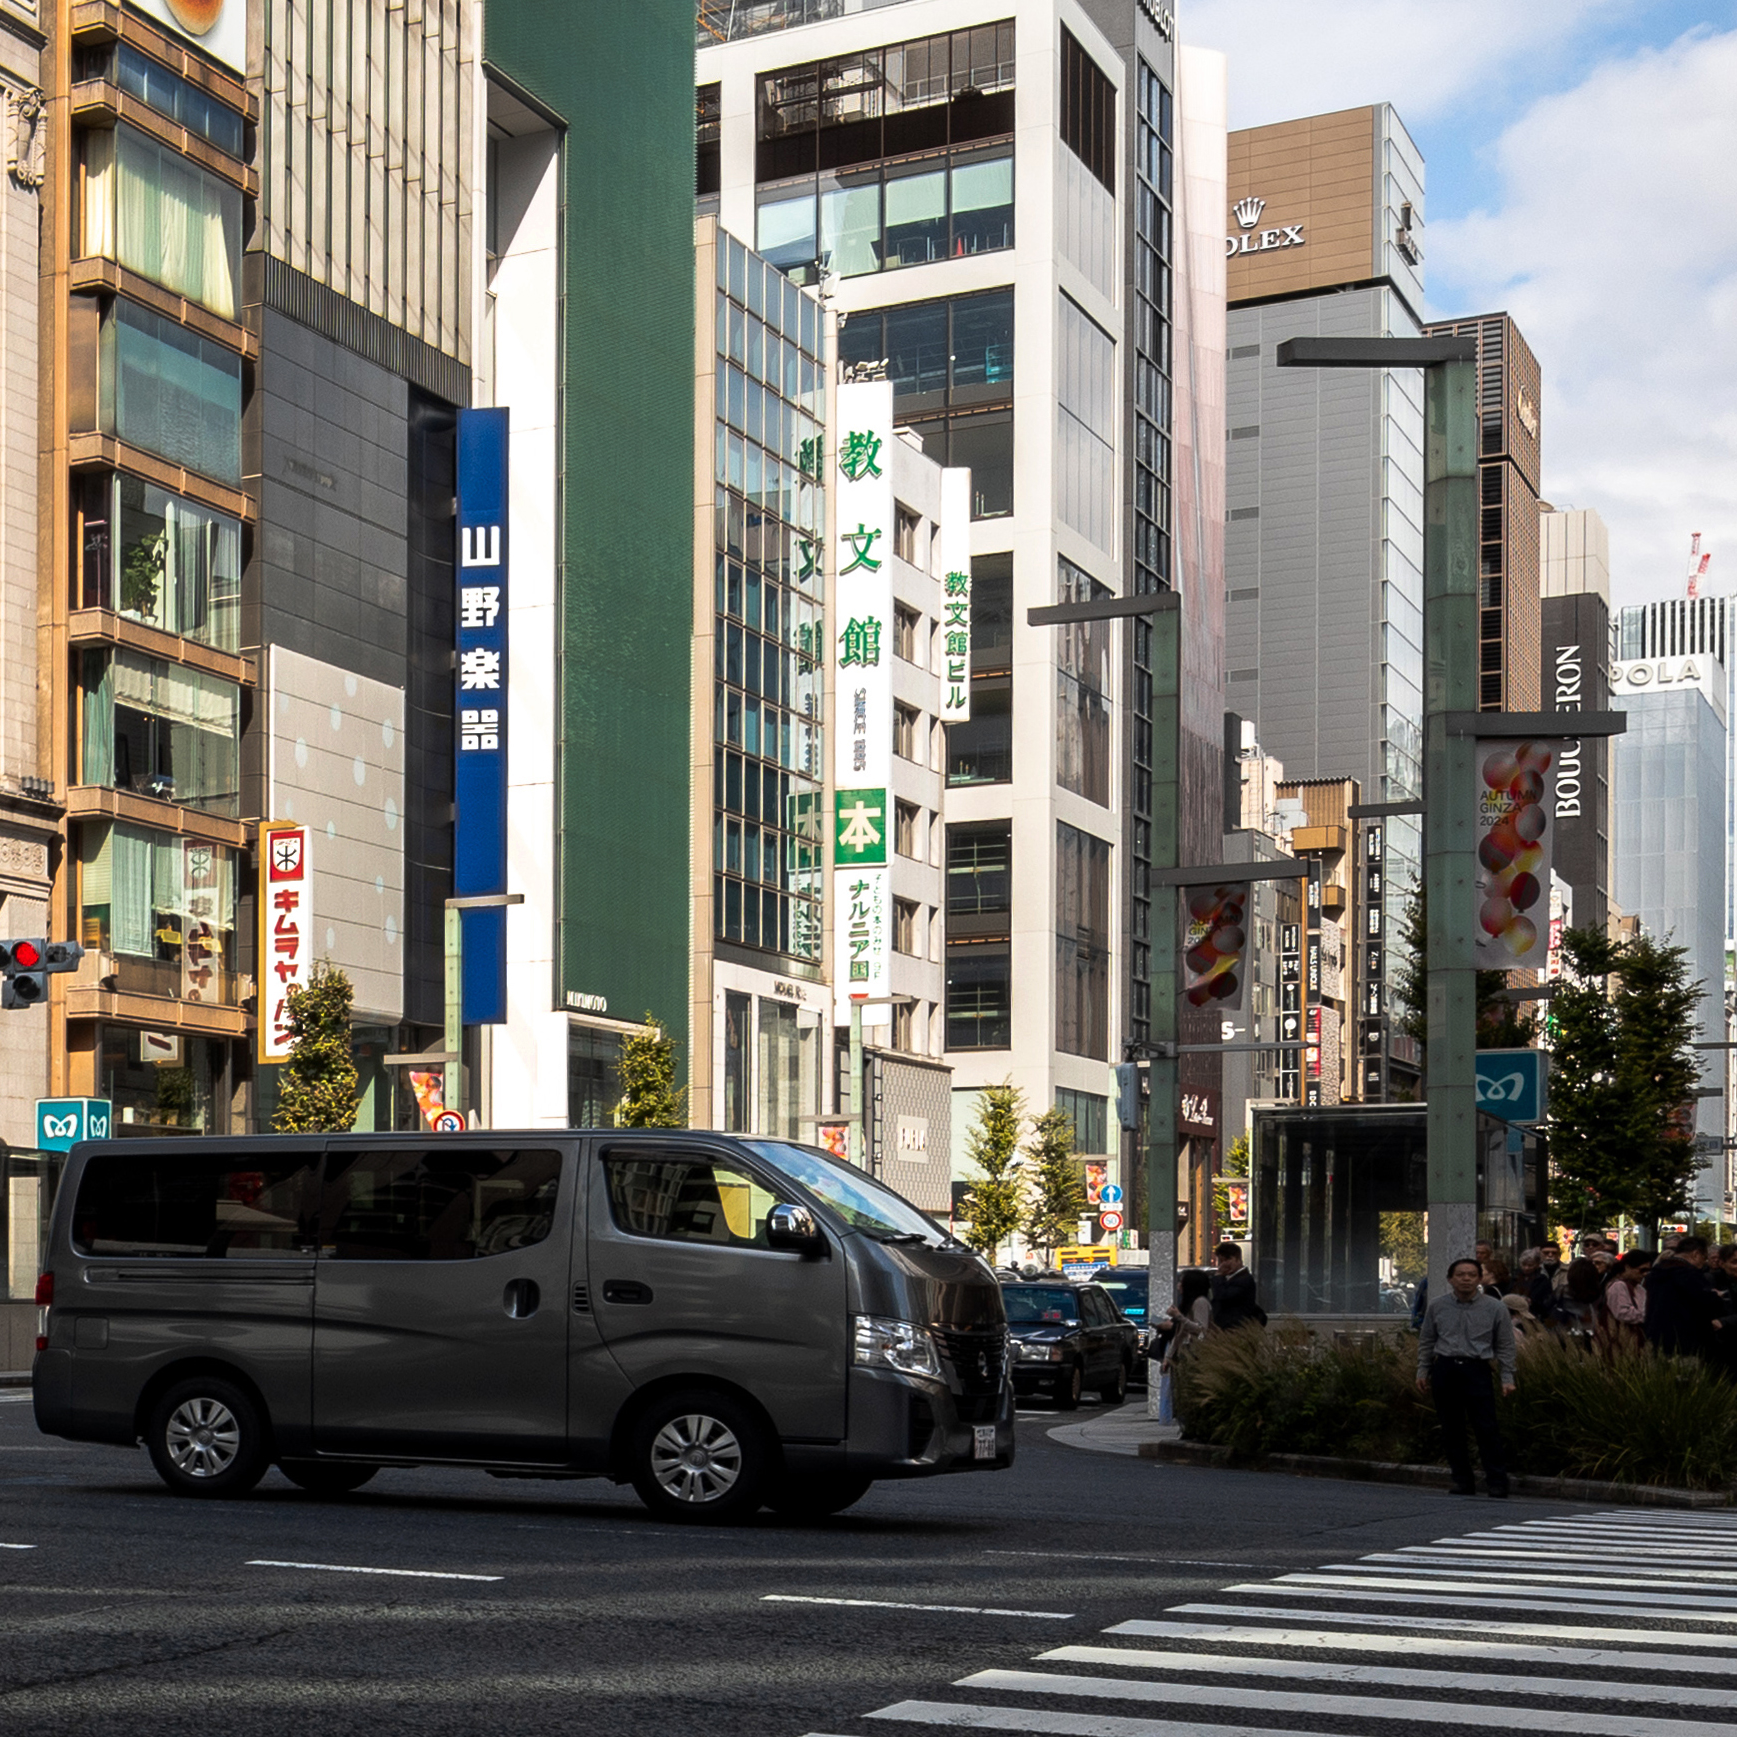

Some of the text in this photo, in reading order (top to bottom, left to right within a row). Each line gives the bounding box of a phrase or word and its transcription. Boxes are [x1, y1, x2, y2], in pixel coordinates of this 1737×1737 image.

[1226, 224, 1305, 257] OLEX
[839, 429, 882, 668] 教文館
[461, 525, 501, 751] 山野楽器
[945, 571, 971, 708] 教文館ビル
[854, 687, 867, 735] SINCE
[1480, 790, 1538, 802] AUTUMN
[1480, 802, 1523, 814] GINZA
[838, 800, 882, 853] 本
[1480, 816, 1510, 827] 2024
[848, 879, 871, 983] ナルニア国
